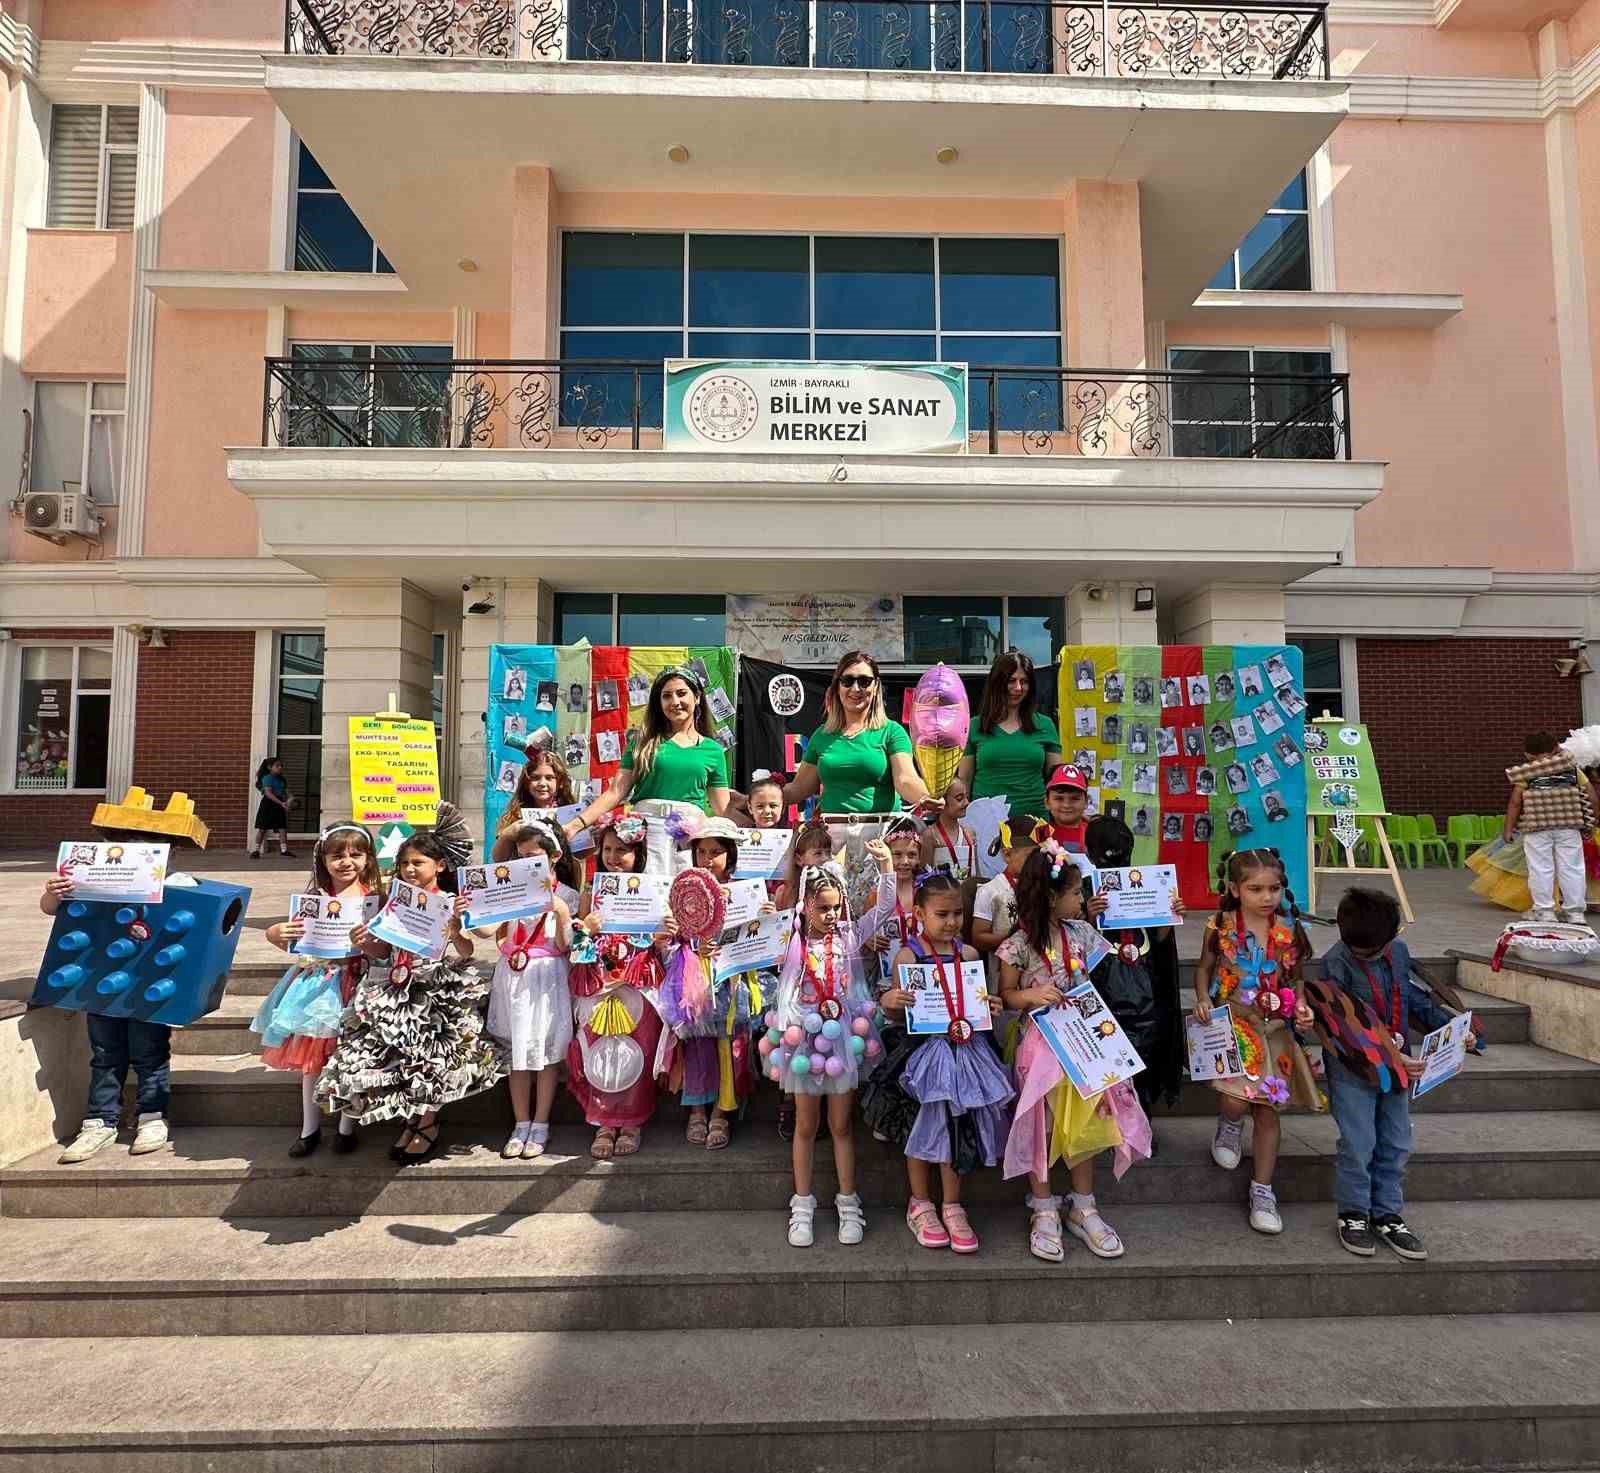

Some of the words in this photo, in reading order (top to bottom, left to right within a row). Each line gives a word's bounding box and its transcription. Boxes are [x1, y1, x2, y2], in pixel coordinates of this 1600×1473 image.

[770, 377, 797, 388] İZMİR
[804, 378, 850, 388] BAYRAKLI
[770, 392, 831, 414] BİLİM
[837, 401, 862, 414] ve
[868, 397, 940, 416] SANAT
[770, 420, 867, 441] MERKEZİ
